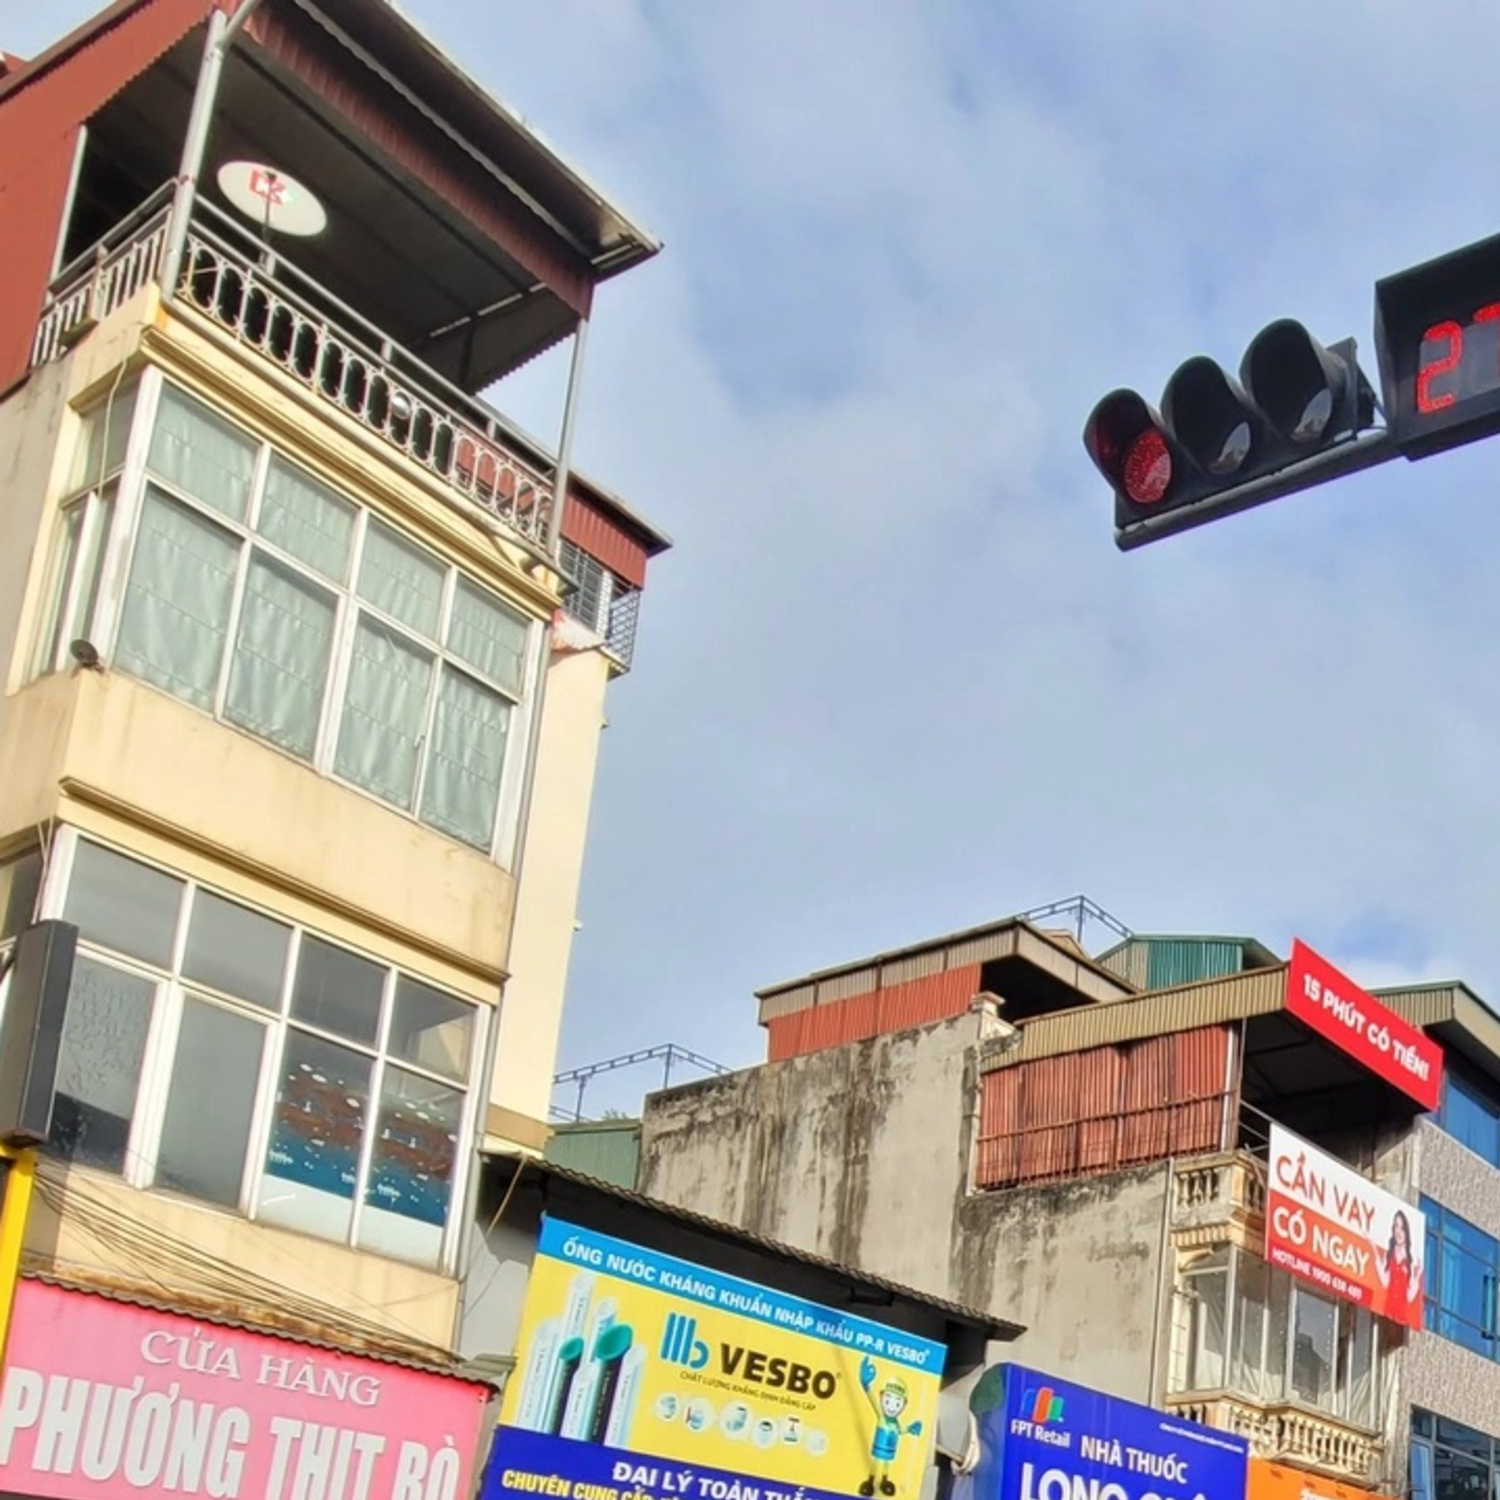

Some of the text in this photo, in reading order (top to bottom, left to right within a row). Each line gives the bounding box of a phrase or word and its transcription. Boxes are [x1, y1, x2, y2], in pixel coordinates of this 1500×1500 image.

[1303, 973, 1321, 1002] 15
[1323, 987, 1367, 1035] PHÚT
[1367, 1022, 1391, 1053] CÓ
[1276, 1151, 1376, 1232] CẦN VAY
[1273, 1207, 1370, 1277] CÓ NGAY
[562, 1235, 603, 1266] ỐNG
[606, 1253, 657, 1282] NƯỚC
[659, 1269, 716, 1301] KHÁNG
[718, 1289, 773, 1318] KHUẨN
[774, 1306, 814, 1333] NHẬP
[816, 1318, 854, 1343] KHẨU
[855, 1333, 886, 1353] PP-R
[140, 1328, 381, 1407] CỬA HÀNG
[720, 1342, 836, 1400] VESBO
[0, 1366, 251, 1499] PHƯƠNG
[1011, 1418, 1071, 1448] FPT Retail
[1081, 1434, 1123, 1467] NHÀ
[1126, 1446, 1189, 1484] THUỐC
[502, 1468, 571, 1498] CHUYÊN
[612, 1461, 657, 1491] ĐẠI
[662, 1469, 695, 1494] LÝ
